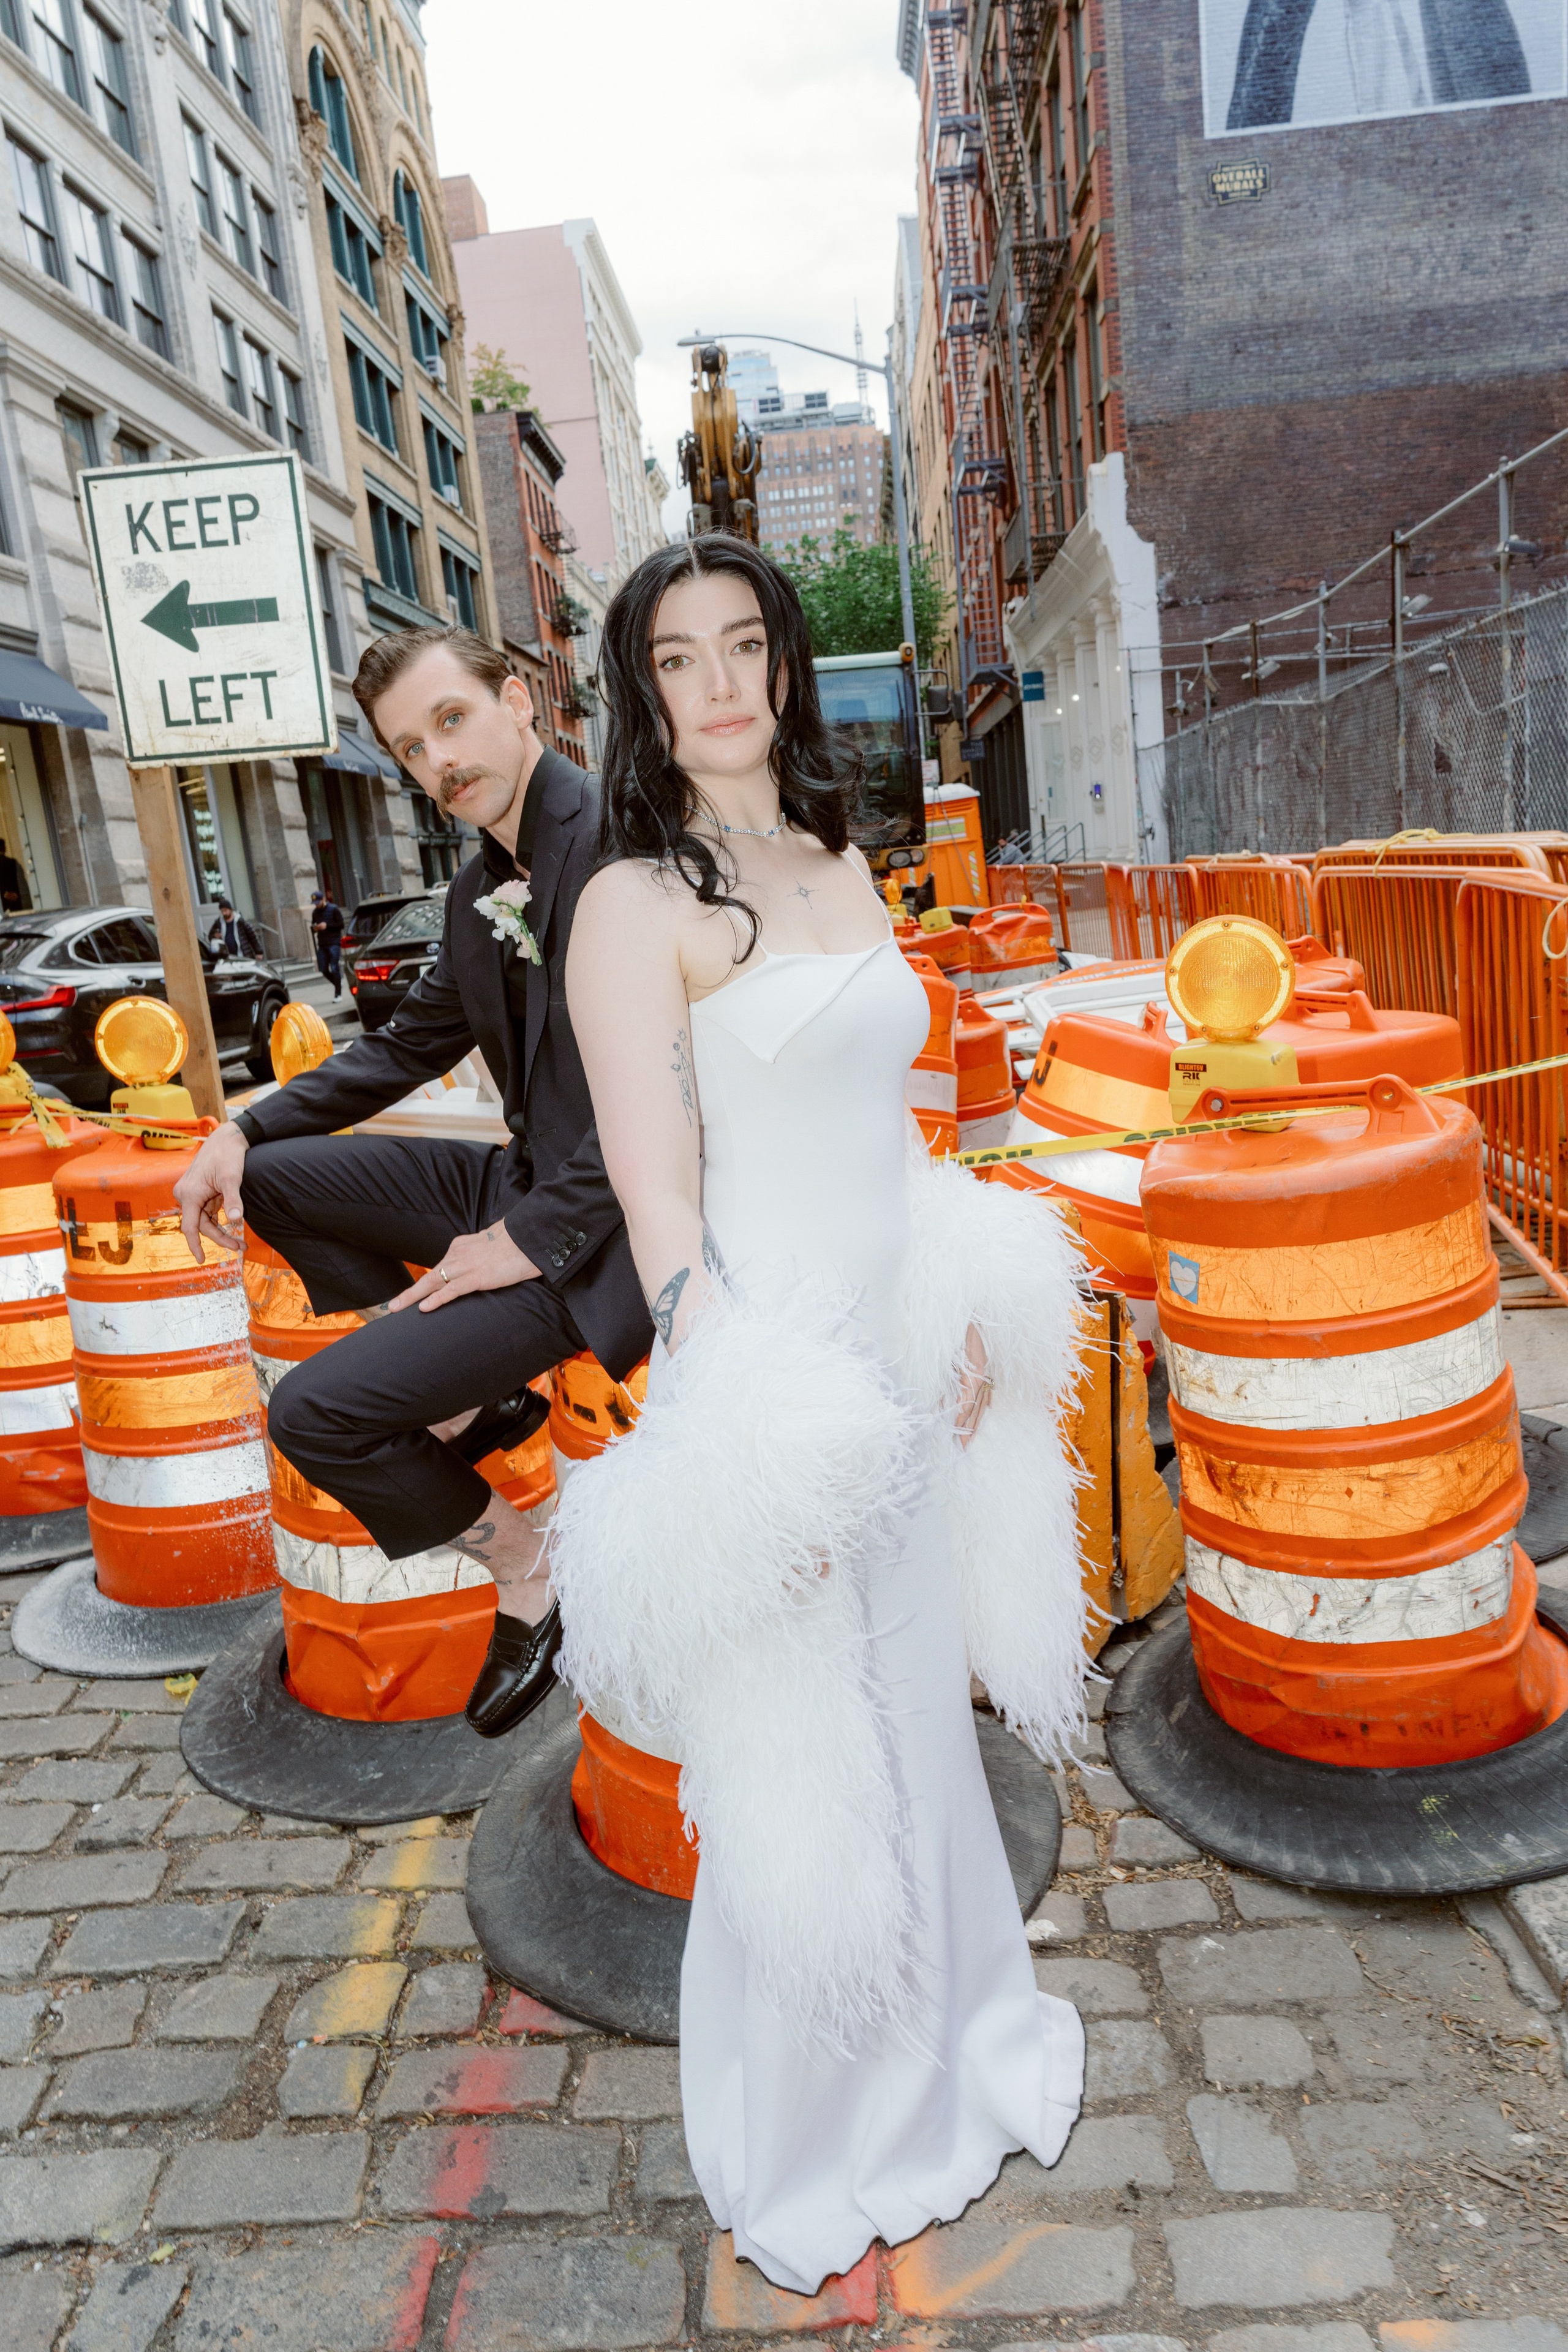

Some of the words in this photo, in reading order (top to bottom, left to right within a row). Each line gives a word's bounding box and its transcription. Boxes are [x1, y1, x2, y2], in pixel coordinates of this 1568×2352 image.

[1212, 168, 1265, 183] OVERALL
[1215, 178, 1263, 192] MURALS
[125, 493, 260, 554] KEEP
[158, 670, 277, 728] LEFT
